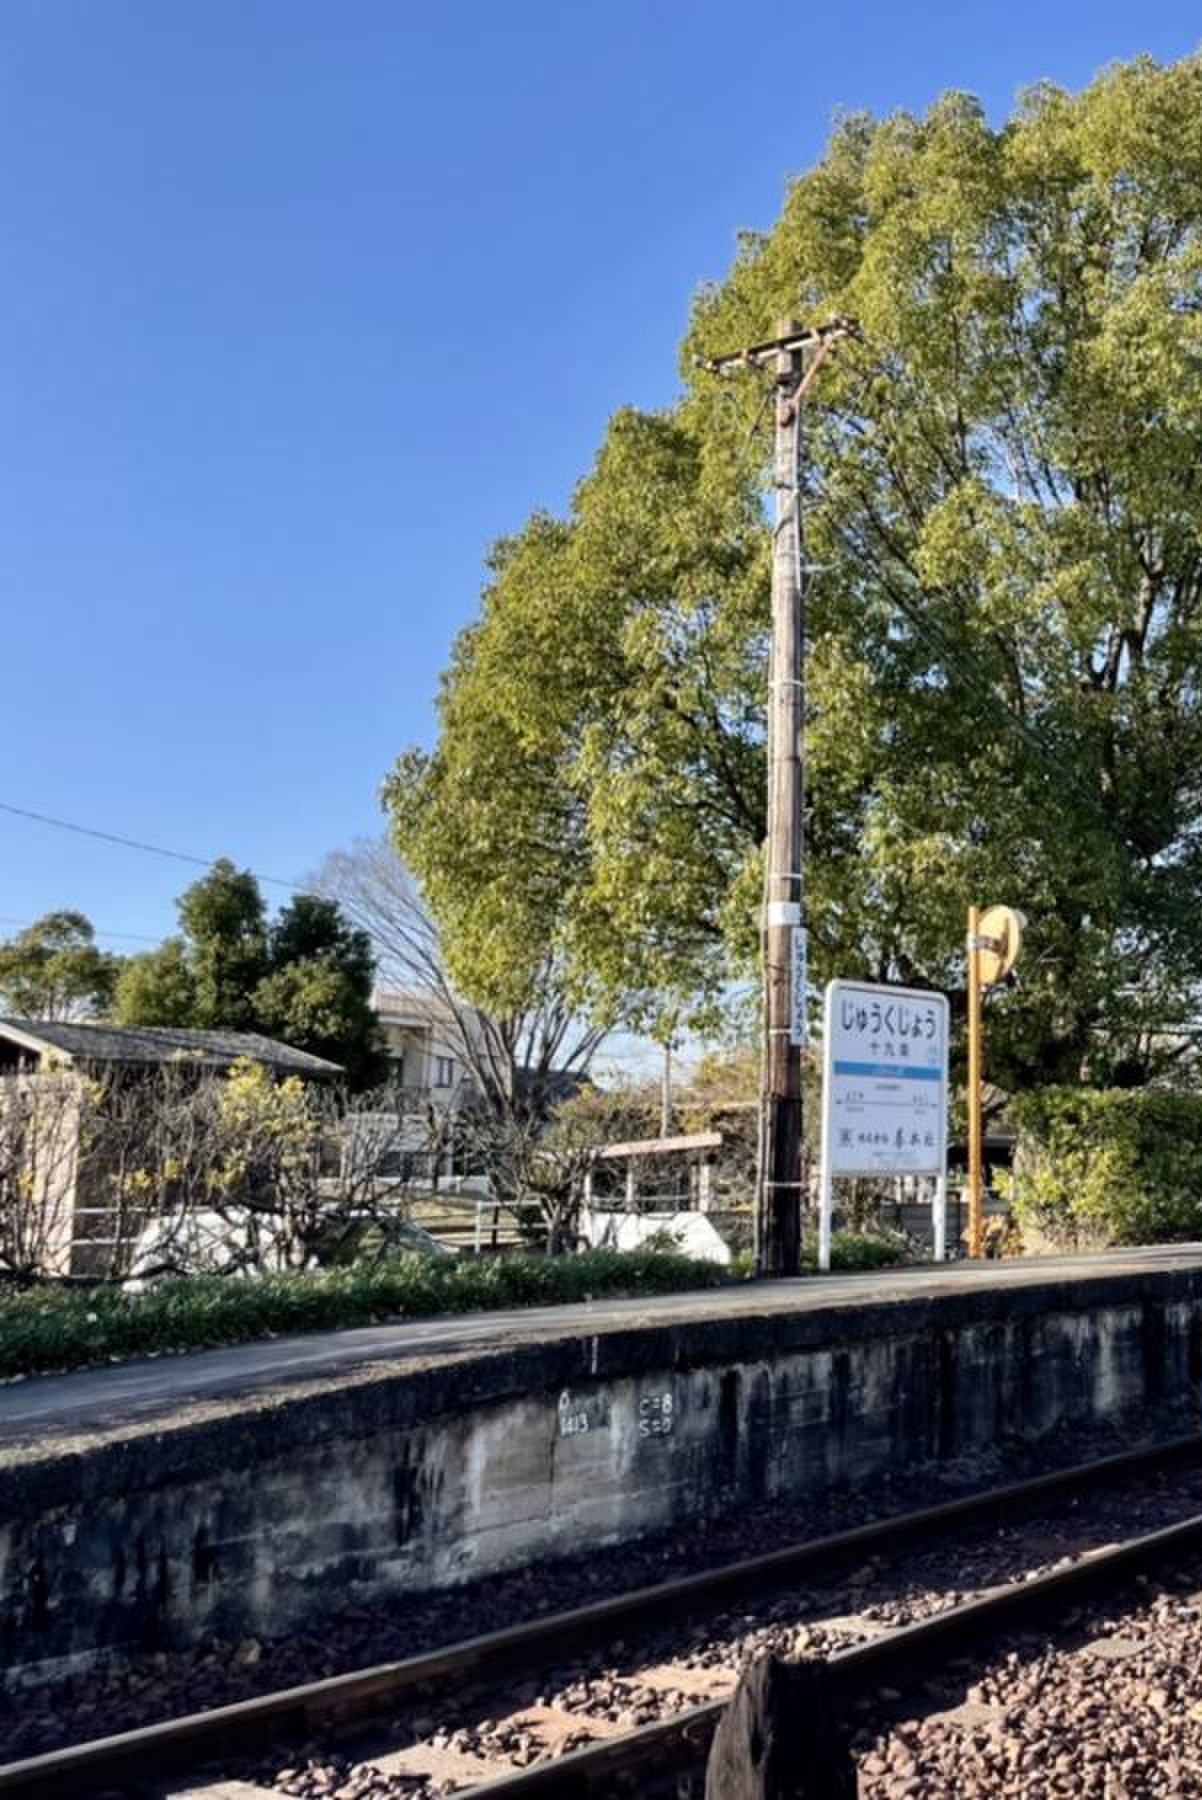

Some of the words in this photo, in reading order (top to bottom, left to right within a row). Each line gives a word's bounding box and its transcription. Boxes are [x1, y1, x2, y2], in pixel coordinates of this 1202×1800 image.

[841, 1000, 936, 1040] じゅうくじょう
